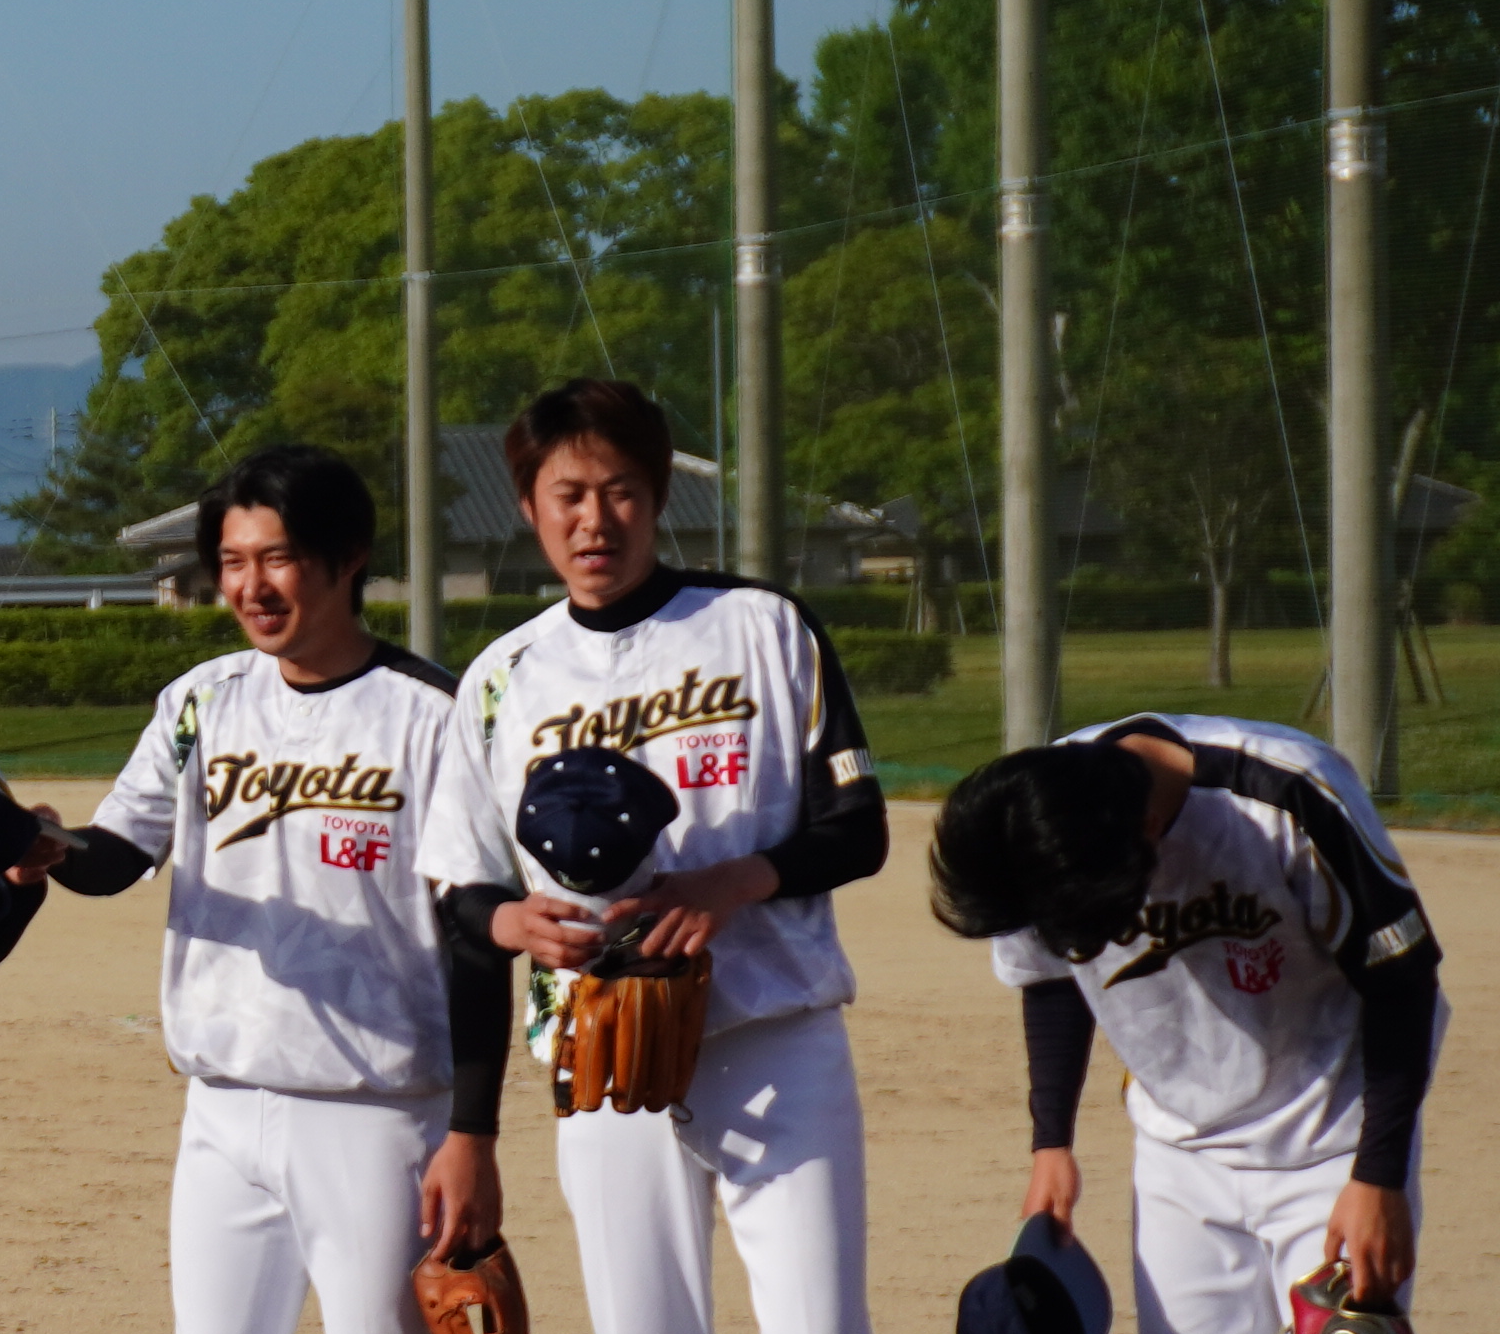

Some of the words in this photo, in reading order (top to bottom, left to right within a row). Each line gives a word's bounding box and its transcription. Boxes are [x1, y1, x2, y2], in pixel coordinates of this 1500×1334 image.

[532, 667, 758, 754] Toyota
[675, 732, 748, 750] TOYOTA
[205, 750, 405, 823] Toyota
[675, 752, 749, 789] L&F
[322, 814, 390, 837] TOYOTA
[320, 832, 391, 872] L&F
